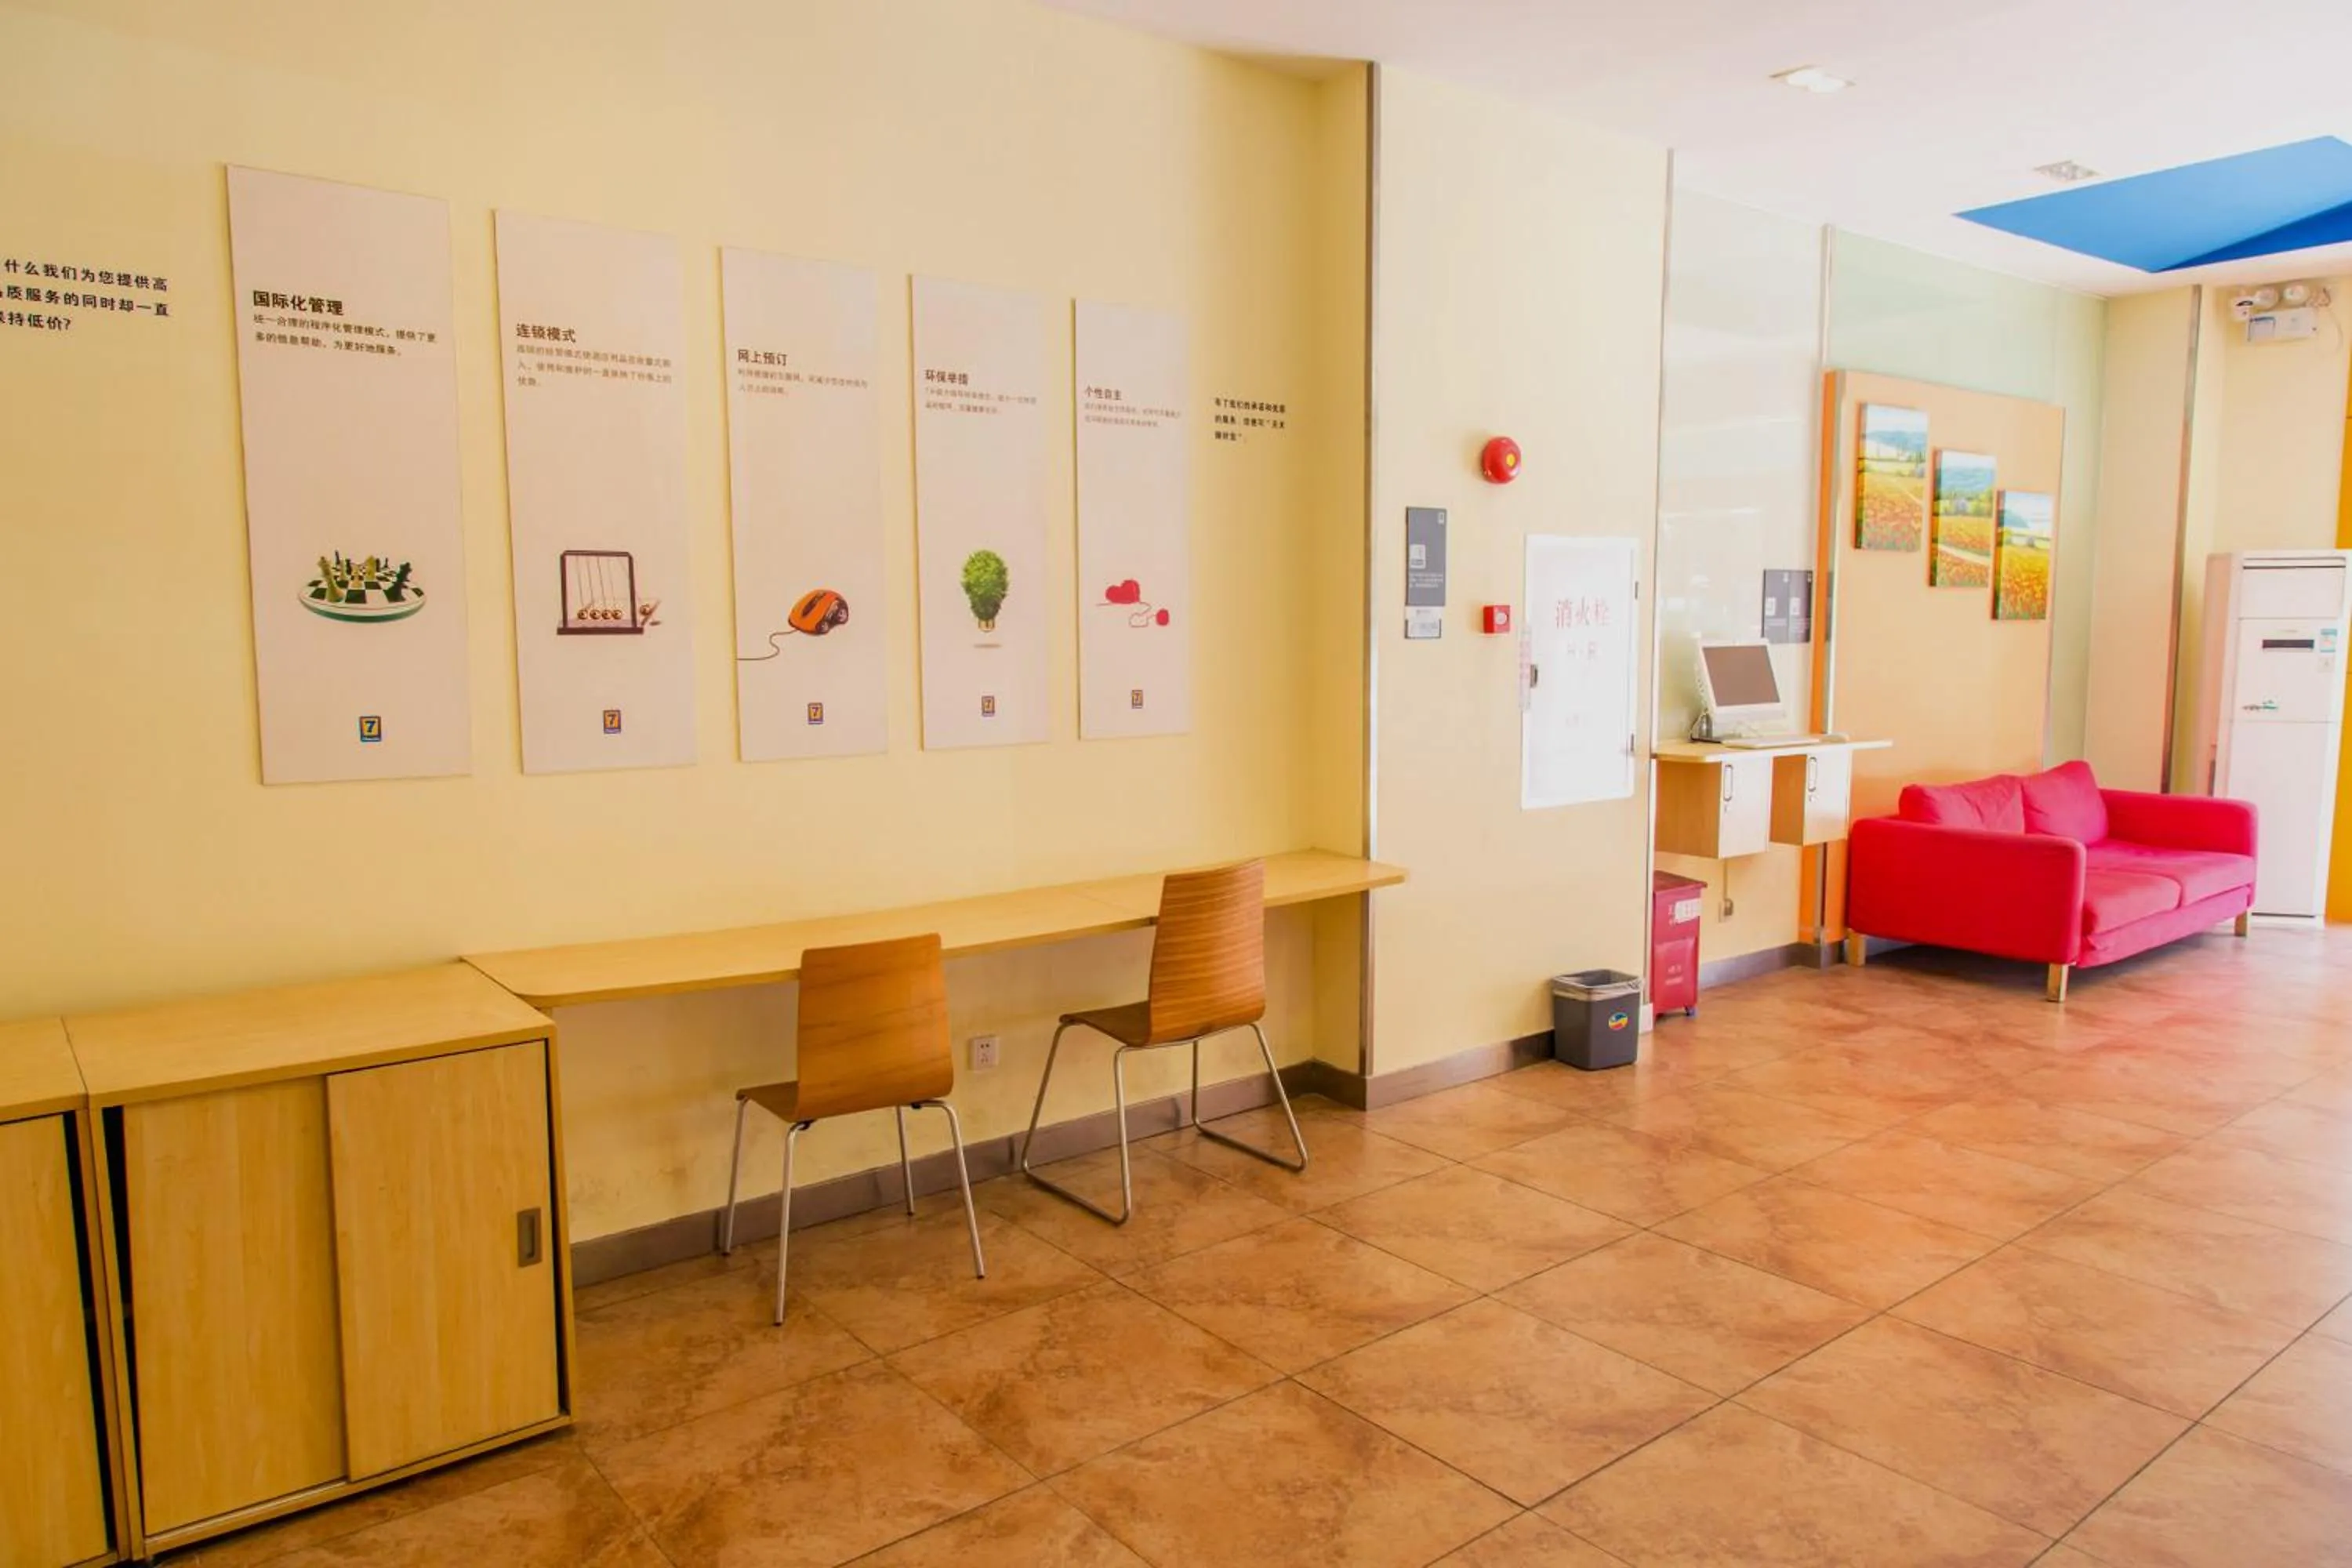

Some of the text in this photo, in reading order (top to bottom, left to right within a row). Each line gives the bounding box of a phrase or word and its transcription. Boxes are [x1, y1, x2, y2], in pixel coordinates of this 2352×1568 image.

[5, 259, 168, 292] 什么我们为您提供高
[0, 285, 170, 317] 质服务的同时却一直
[252, 290, 344, 316] 国际化管理
[516, 323, 576, 343] 连锁模式
[738, 349, 788, 366] 网上预订
[1555, 595, 1612, 630] 消火栓
